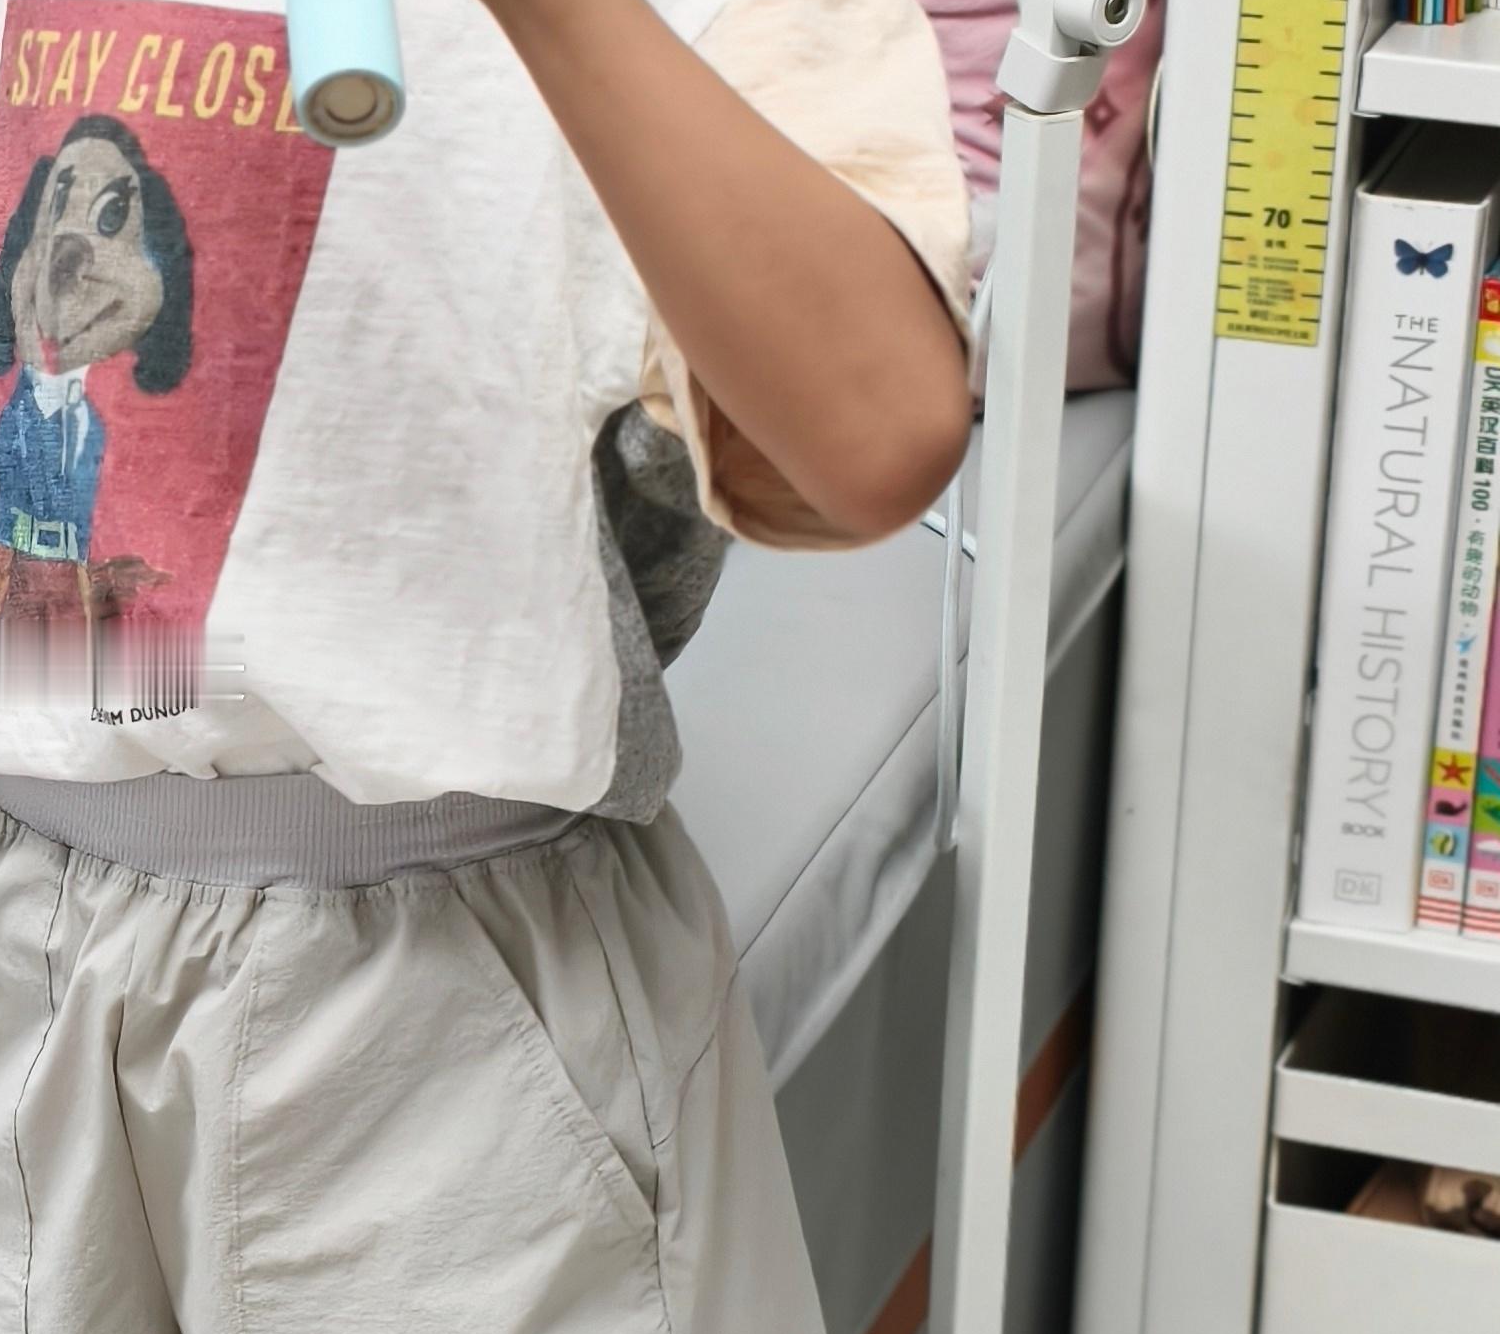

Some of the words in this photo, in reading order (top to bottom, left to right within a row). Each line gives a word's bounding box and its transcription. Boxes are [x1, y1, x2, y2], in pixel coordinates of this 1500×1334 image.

[11, 28, 117, 107] STAY
[1263, 207, 1291, 229] 70
[1394, 314, 1440, 333] THE
[1366, 335, 1436, 588] NATURAL
[1345, 605, 1408, 819] HISTORY
[1341, 821, 1385, 838] BOOK
